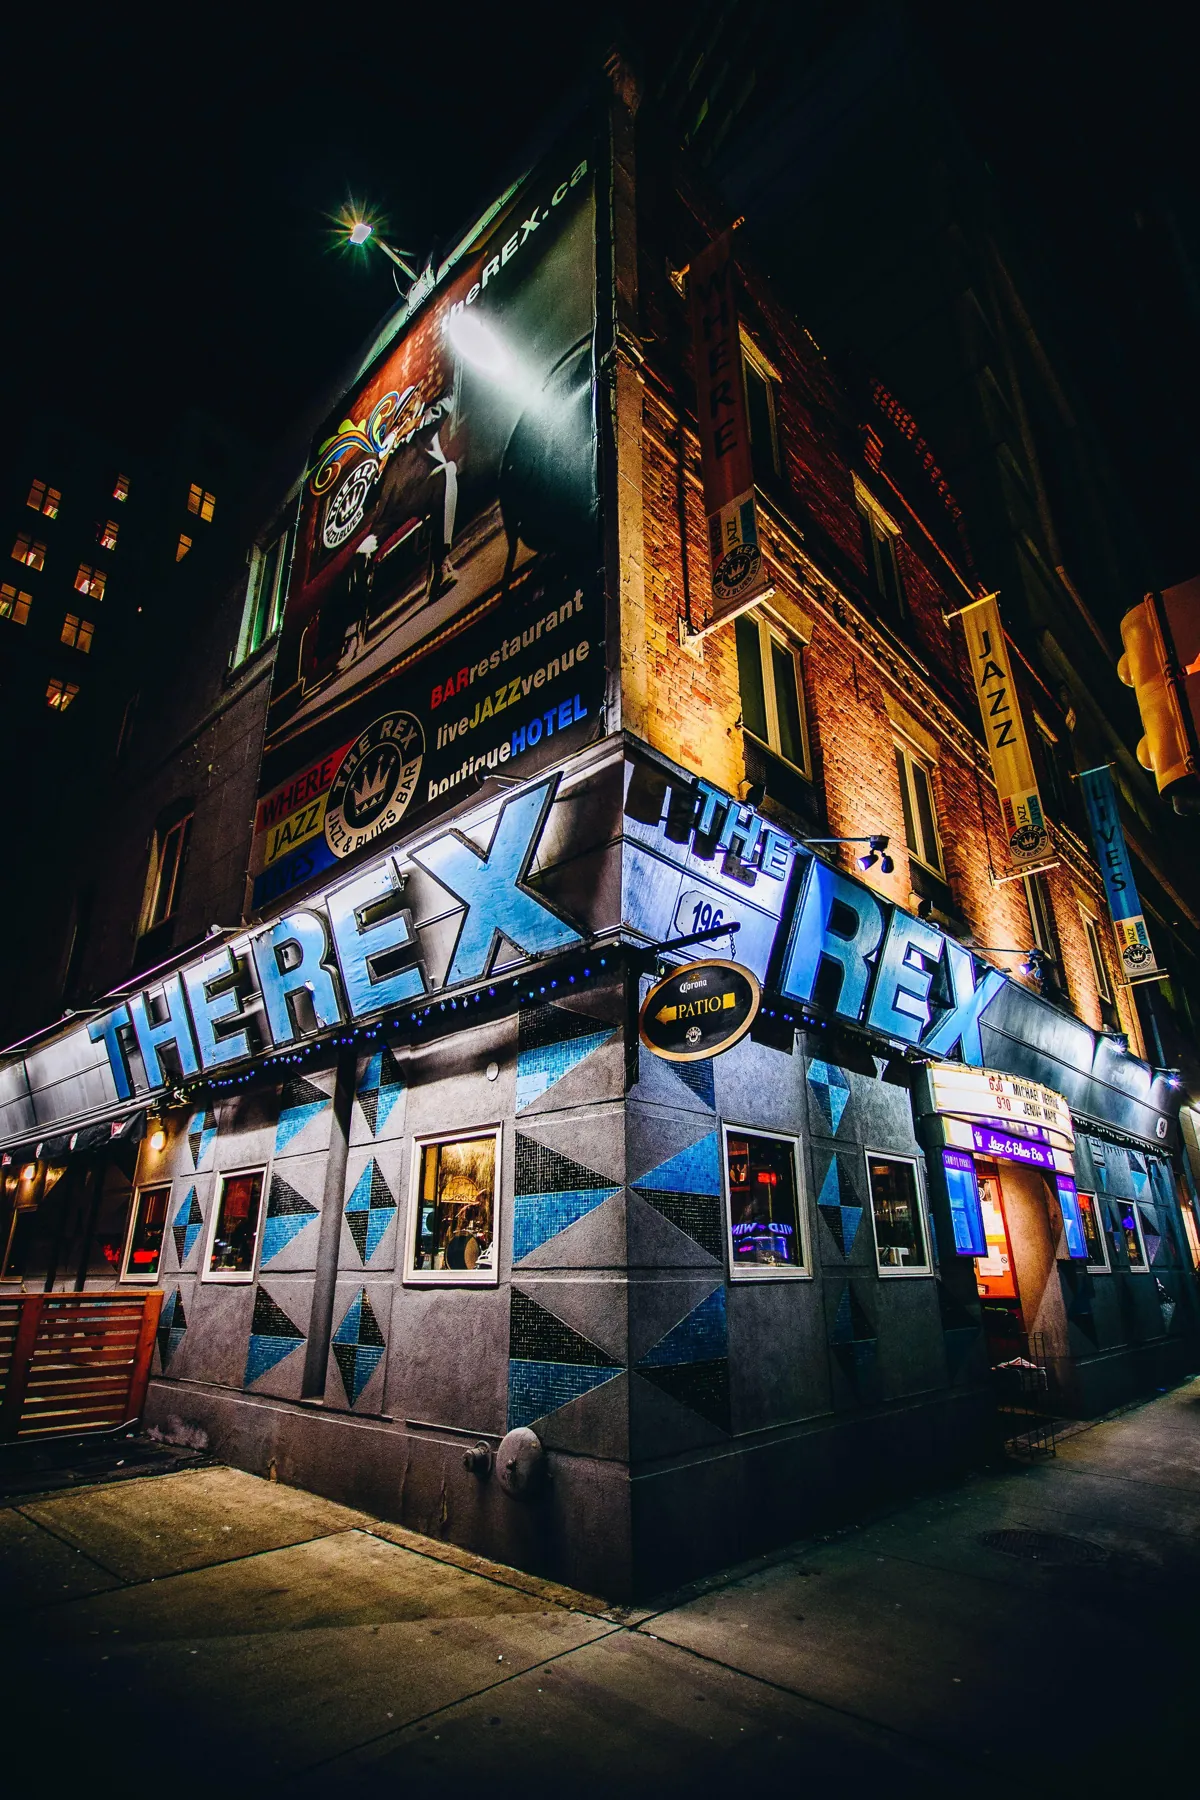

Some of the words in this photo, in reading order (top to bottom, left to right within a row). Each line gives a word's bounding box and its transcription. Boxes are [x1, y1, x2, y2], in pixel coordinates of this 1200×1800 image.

[704, 260, 737, 460] WHERE
[726, 516, 741, 547] JAZZ
[736, 546, 757, 556] REX
[430, 588, 585, 711] BARrestaurant
[436, 639, 591, 751] liveJAZZvenue
[978, 630, 1017, 749] JAZZ
[333, 734, 371, 793] THE
[380, 719, 418, 751] REX
[261, 757, 334, 826] WHERE
[328, 812, 347, 848] JAZZ
[342, 835, 353, 853] &
[395, 762, 418, 805] BAR
[1016, 804, 1030, 824] JAZZ
[268, 801, 321, 862] JAZZ
[1011, 827, 1025, 842] THE
[1027, 825, 1044, 835] REX
[1092, 783, 1127, 893] LIVES
[86, 945, 254, 1100] THE
[248, 770, 592, 1049] REX
[692, 900, 724, 942] 196
[696, 776, 790, 881] THE
[782, 854, 1009, 1067] REX
[678, 996, 722, 1019] PATIO
[679, 979, 708, 994] Corona
[988, 1077, 1004, 1093] 630
[988, 1136, 1005, 1152] Jazz
[1005, 1140, 1013, 1154] &
[1013, 1142, 1031, 1159] Blues
